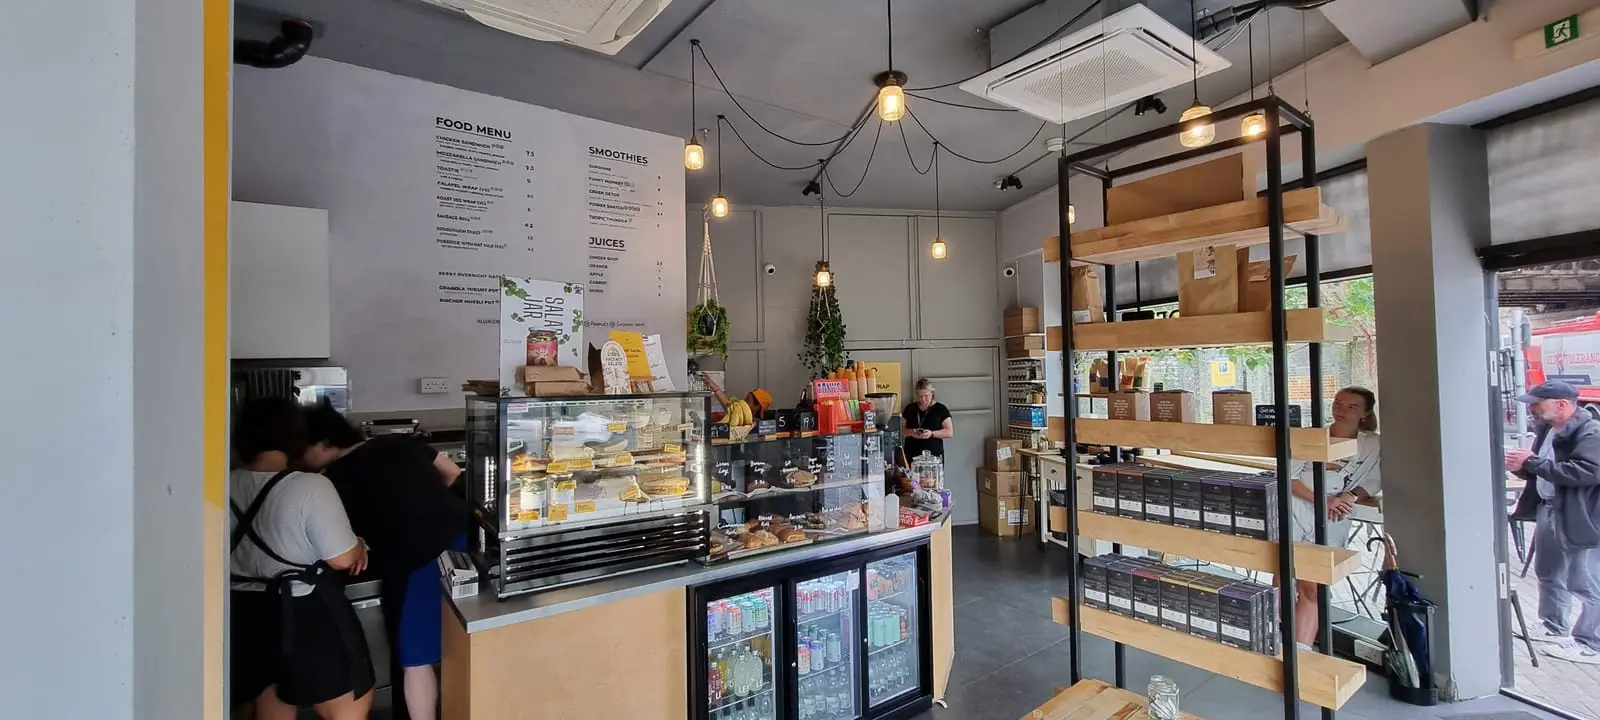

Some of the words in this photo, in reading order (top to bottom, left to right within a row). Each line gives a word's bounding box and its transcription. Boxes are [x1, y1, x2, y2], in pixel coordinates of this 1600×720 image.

[435, 117, 473, 131] FOOD
[476, 125, 512, 139] MENU
[436, 135, 460, 143] CHICKEN
[461, 139, 490, 149] SANDWICH
[436, 150, 473, 160] MOZZARELLA
[473, 156, 502, 165] SANDWICH
[588, 146, 649, 164] SMOOTHIES
[588, 236, 625, 248] JUICES
[523, 297, 543, 318] JAR
[778, 416, 786, 427] 5
